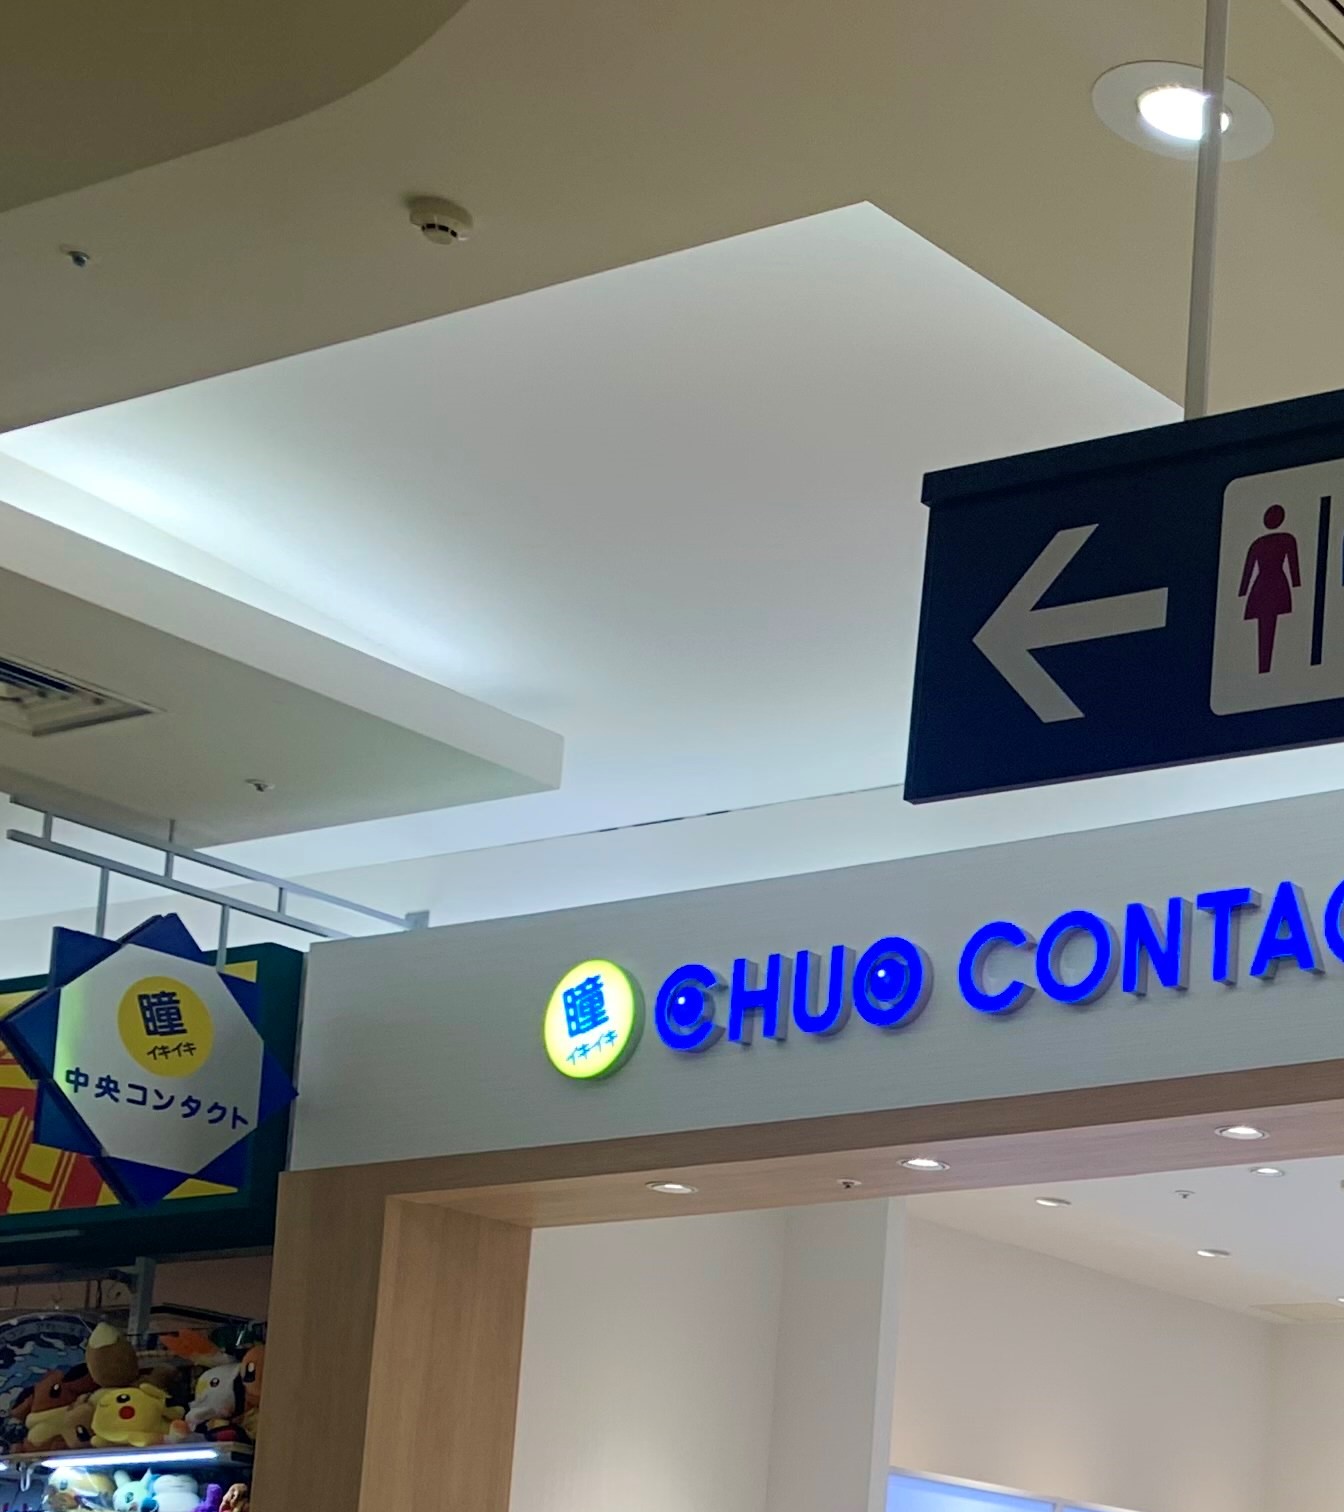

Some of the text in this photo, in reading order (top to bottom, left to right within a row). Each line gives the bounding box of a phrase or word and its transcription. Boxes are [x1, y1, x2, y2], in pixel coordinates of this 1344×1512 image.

[137, 989, 188, 1038] 瞳
[561, 973, 610, 1038] 瞳
[654, 934, 926, 1054] CHUO
[146, 1041, 198, 1061] イキイキ
[565, 1028, 619, 1066] イキイキ
[64, 1065, 250, 1131] 中央コンタクト
